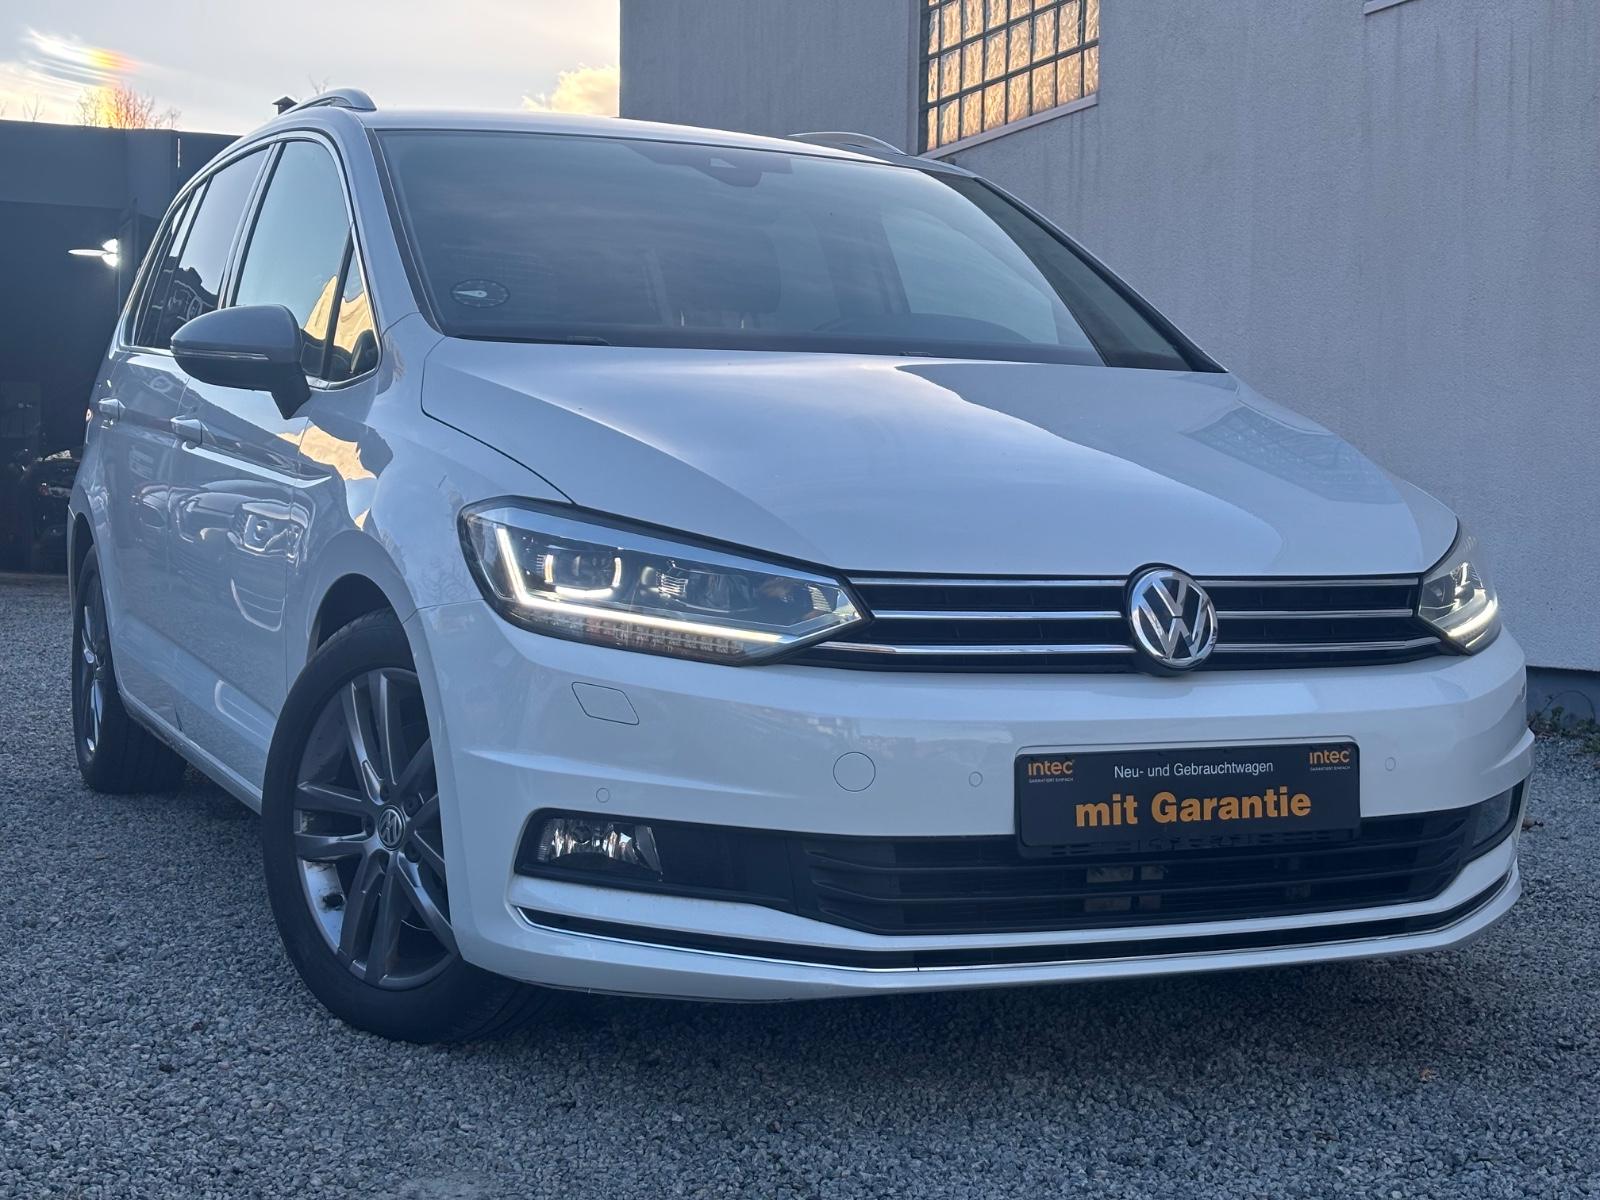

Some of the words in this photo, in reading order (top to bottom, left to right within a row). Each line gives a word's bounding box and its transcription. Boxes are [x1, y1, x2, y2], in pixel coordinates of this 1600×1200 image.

[1309, 750, 1350, 764] intec
[1028, 760, 1073, 776] intec
[1114, 765, 1144, 778] Neu-
[1147, 764, 1170, 777] und
[1173, 761, 1274, 776] Gebrauchtwagen
[1075, 793, 1138, 827] mit
[1151, 786, 1312, 824] Garantie
